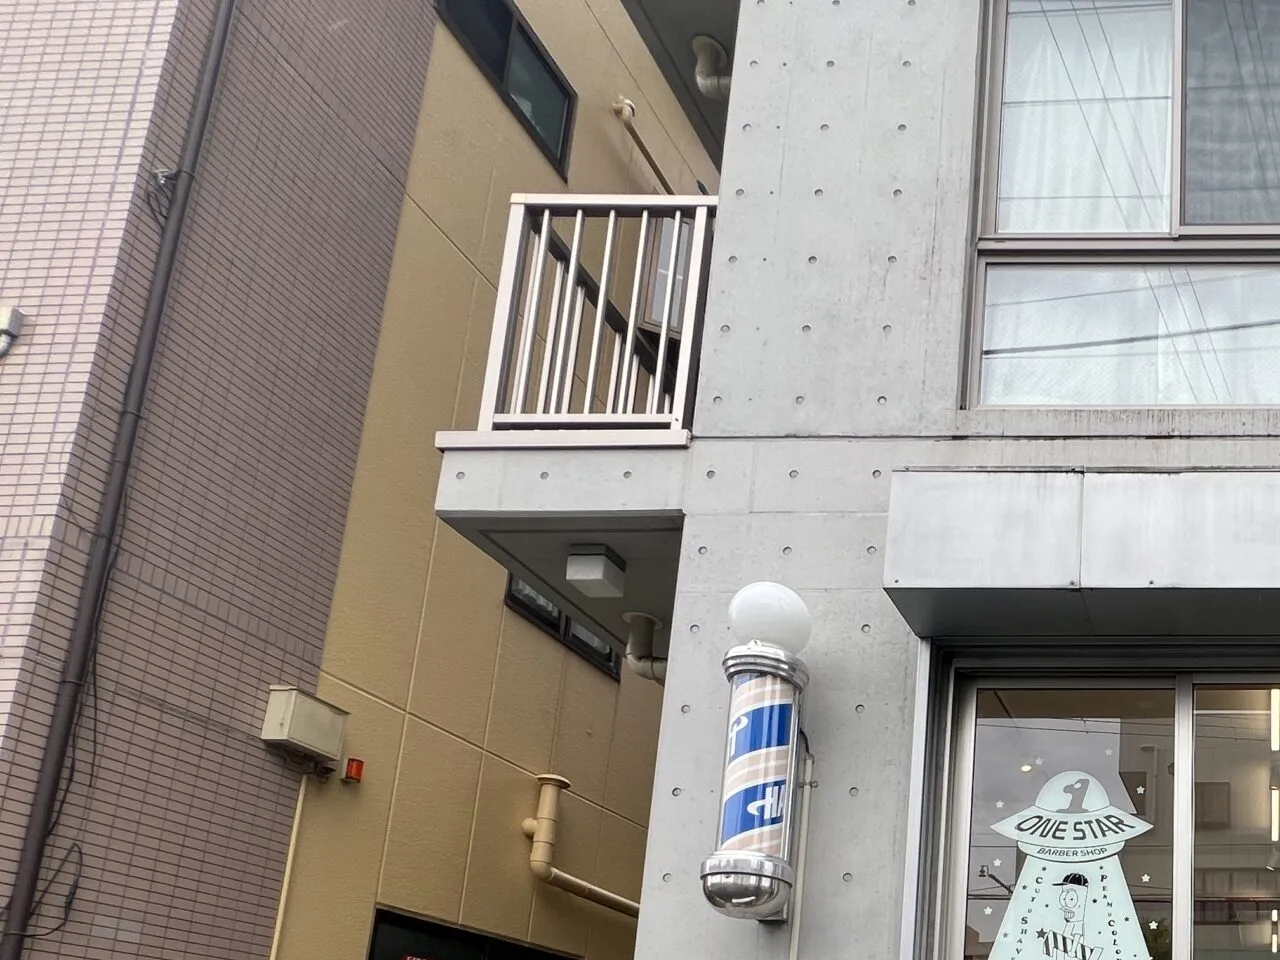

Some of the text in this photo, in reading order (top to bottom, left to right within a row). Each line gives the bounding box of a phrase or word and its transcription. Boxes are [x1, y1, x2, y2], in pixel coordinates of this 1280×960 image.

[1015, 814, 1136, 841] ONE STAR
[1037, 847, 1108, 857] BARBER SHOP
[1030, 876, 1044, 903] CUT
